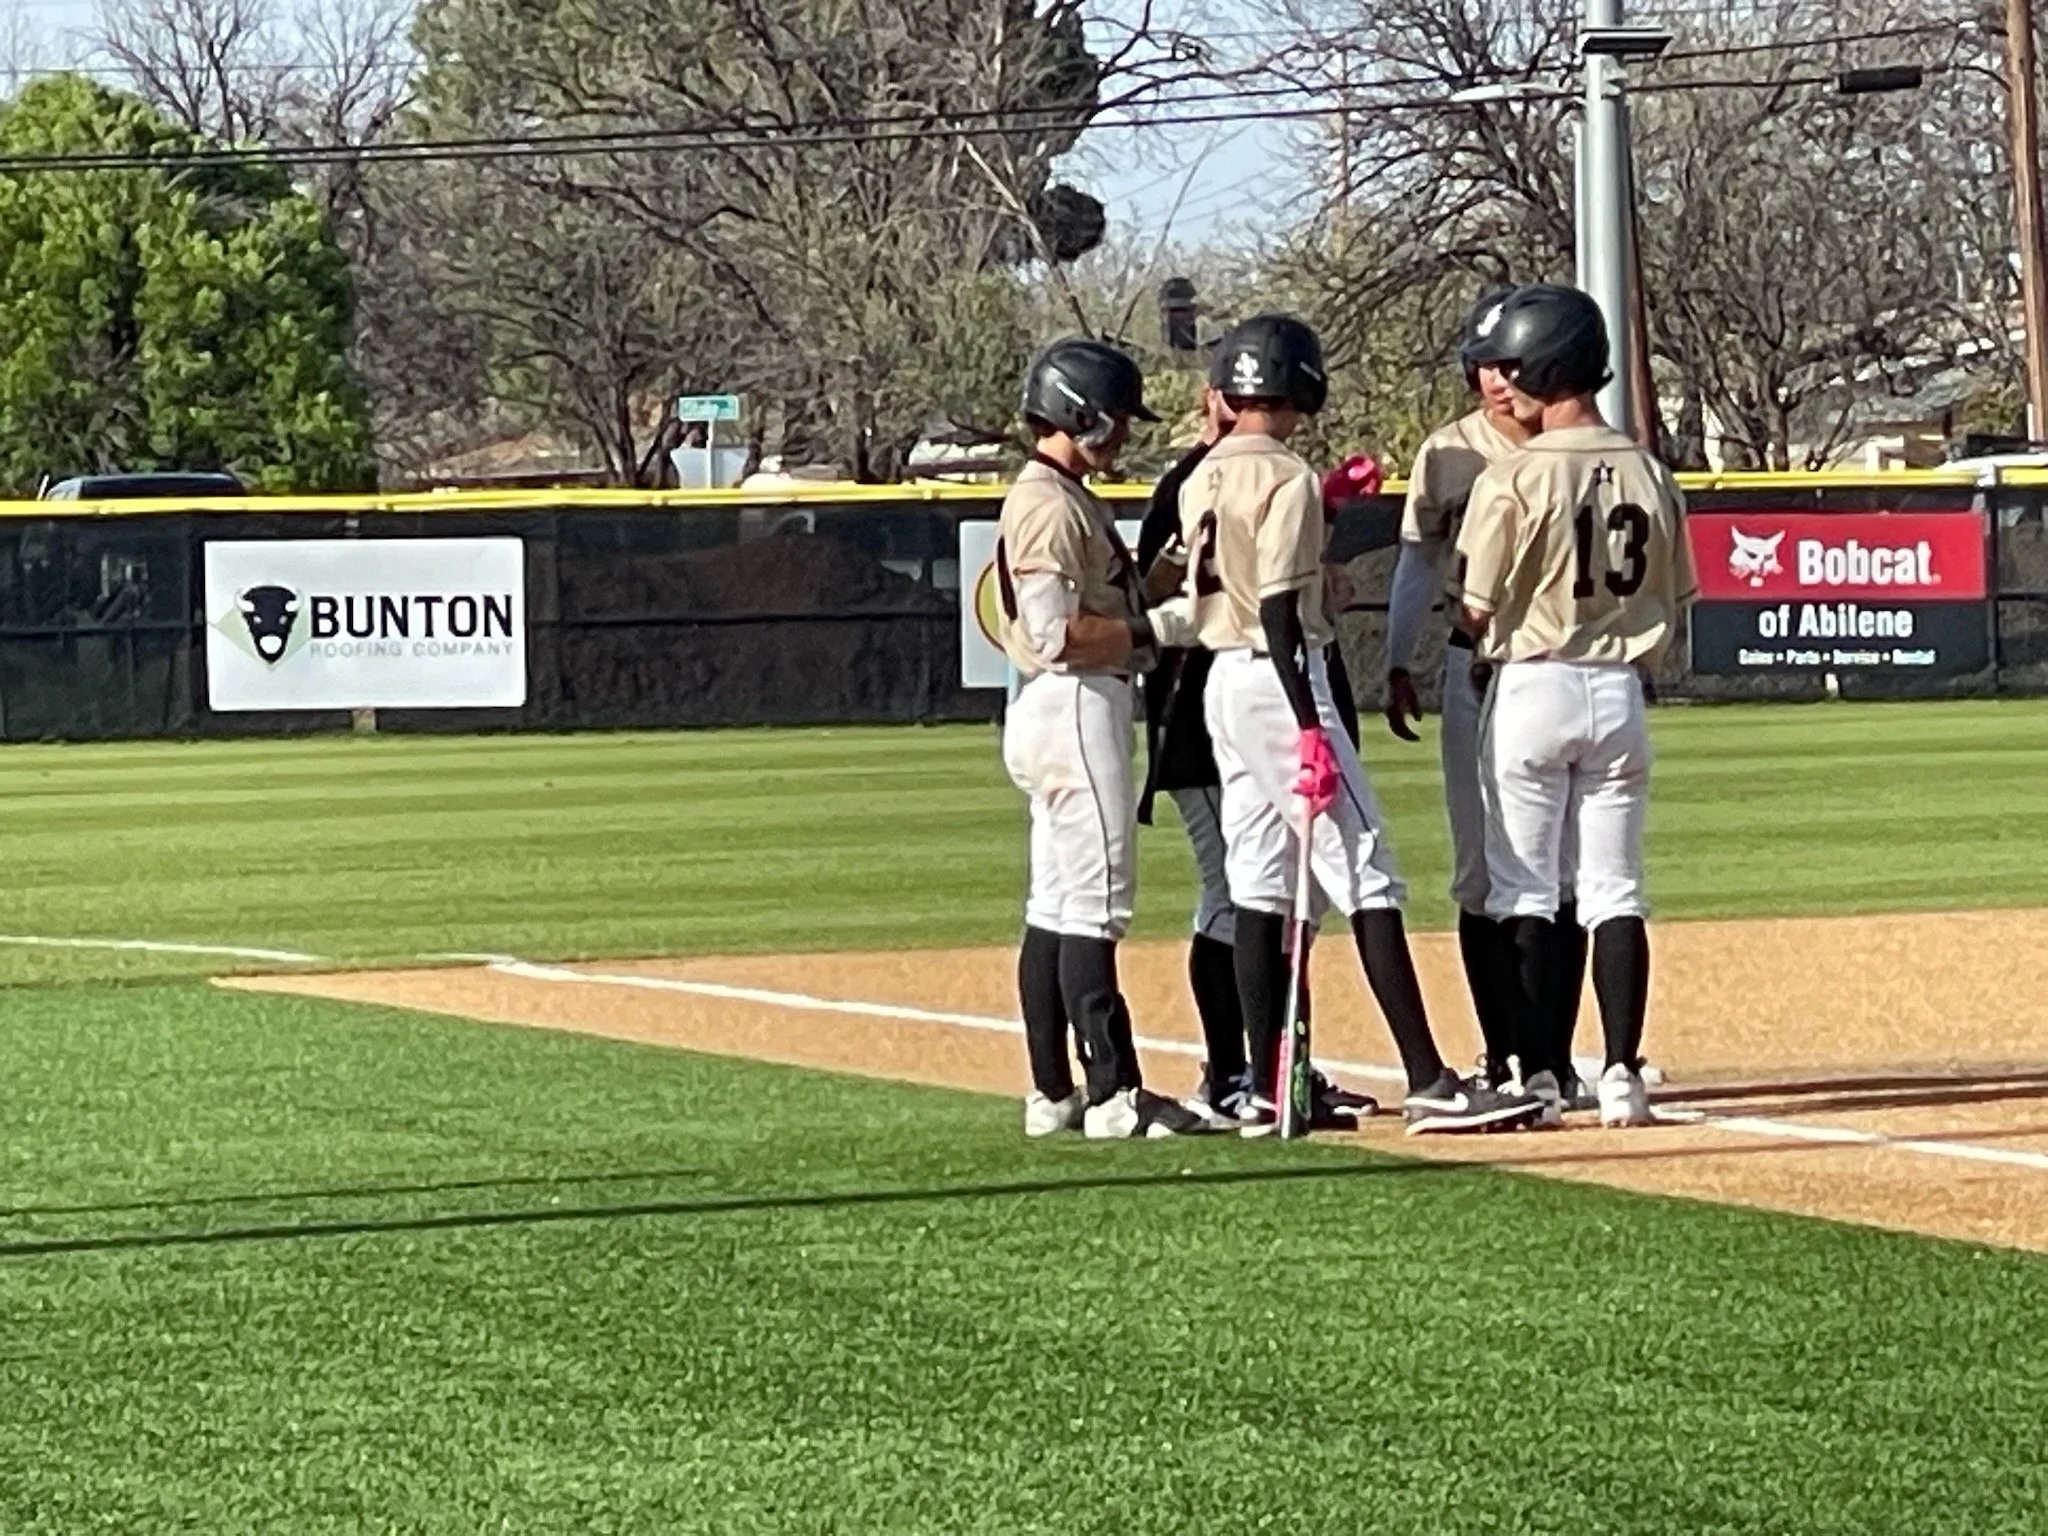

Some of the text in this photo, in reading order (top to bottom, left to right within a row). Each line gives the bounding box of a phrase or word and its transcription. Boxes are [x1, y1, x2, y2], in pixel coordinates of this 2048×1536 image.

[1573, 502, 1650, 599] 13
[1797, 539, 1932, 586] Bobcat
[310, 593, 513, 638] BUNTON
[1758, 603, 1913, 638] of Abilene
[309, 640, 514, 659] ROOFING COMPANY
